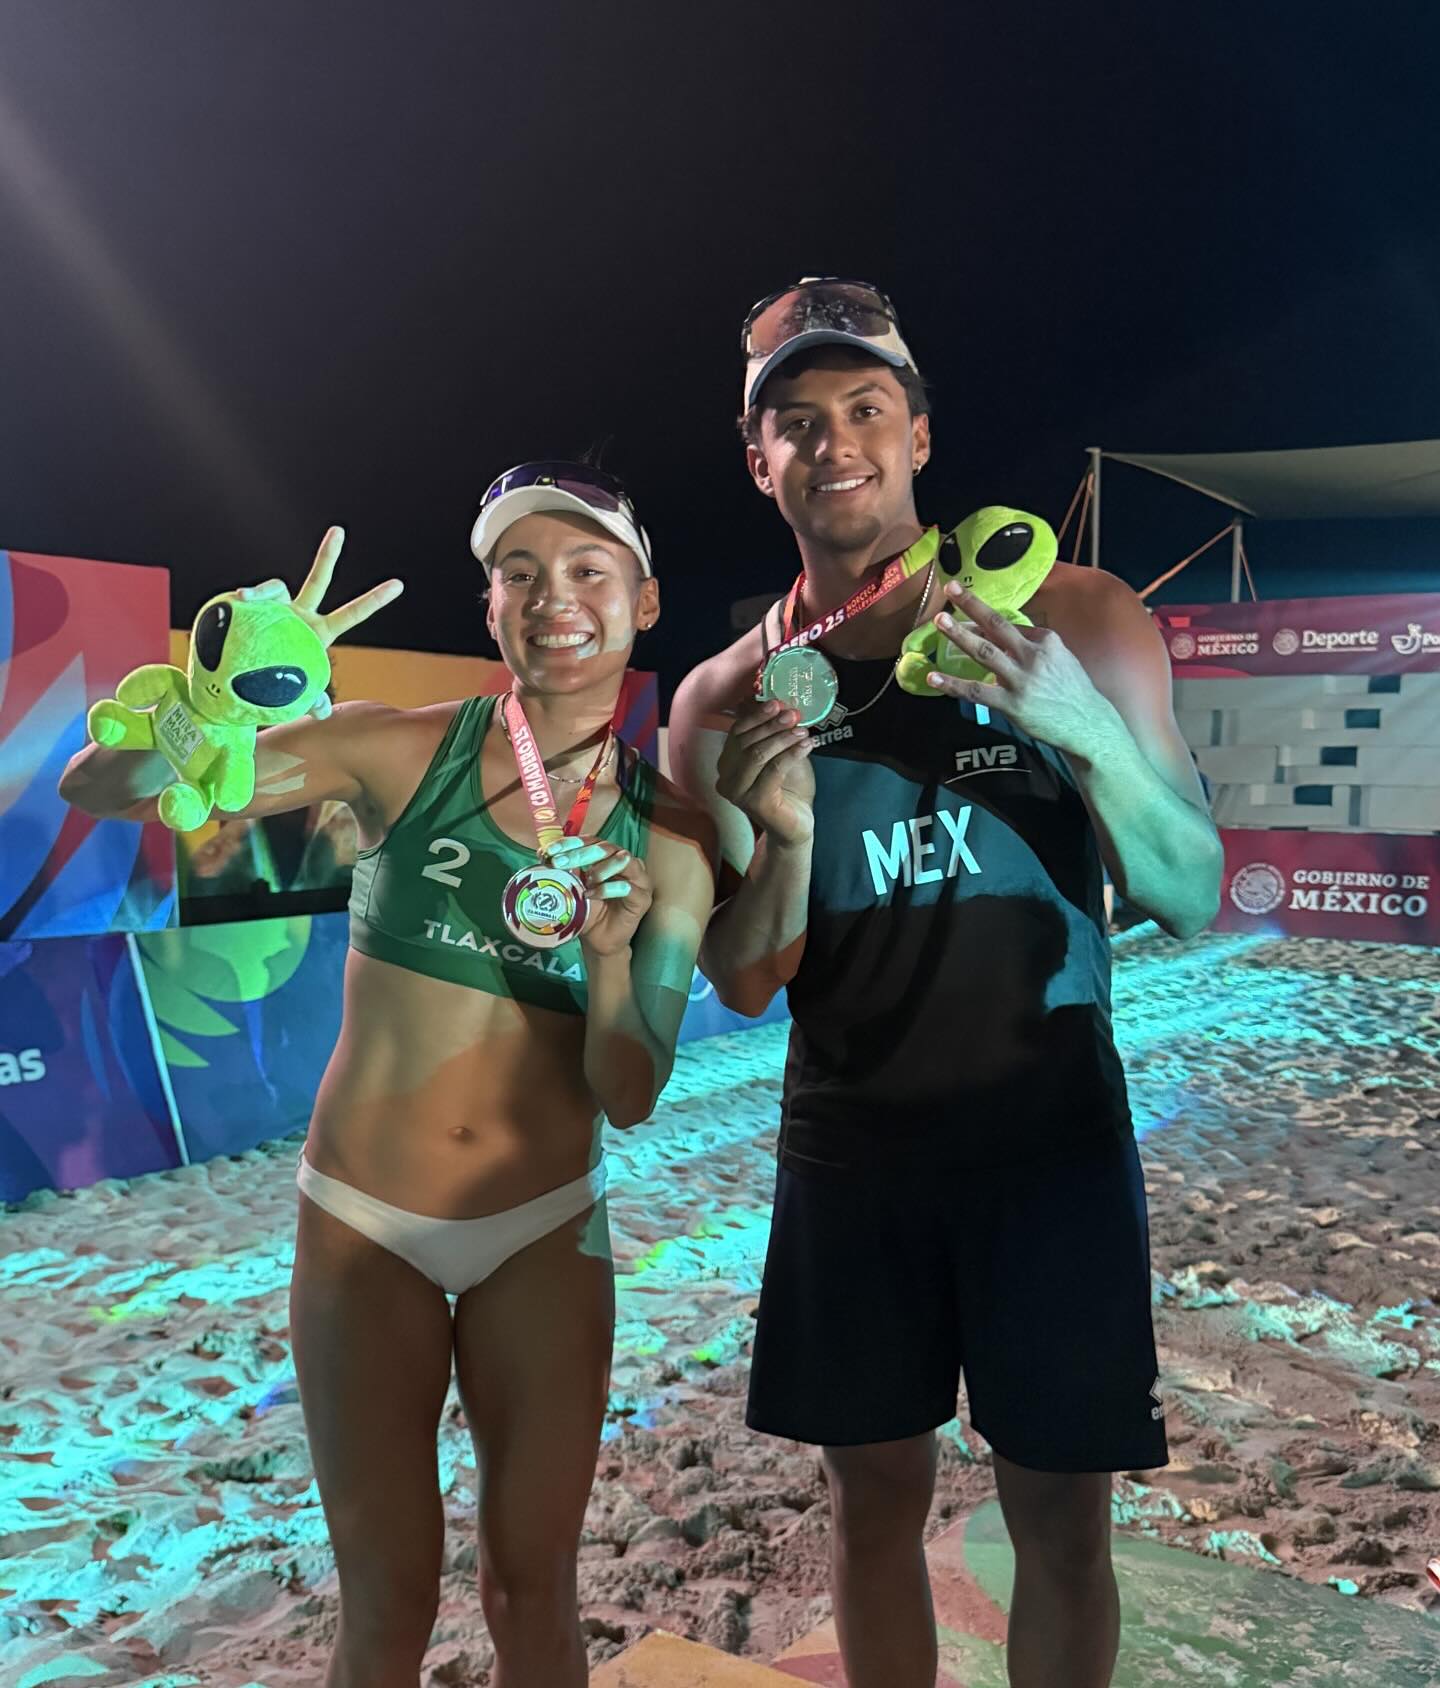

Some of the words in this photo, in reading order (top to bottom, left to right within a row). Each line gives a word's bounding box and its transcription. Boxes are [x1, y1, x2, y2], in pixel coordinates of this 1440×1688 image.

[824, 608, 845, 633] 25
[1197, 641, 1260, 656] MÉXICO
[1302, 629, 1379, 650] Deporte
[514, 726, 529, 746] 25
[518, 740, 546, 792] MADERO
[955, 744, 1018, 771] FIVB
[421, 837, 471, 889] 2
[861, 805, 983, 896] MEX
[1292, 869, 1397, 888] GOBIERNO
[1402, 875, 1430, 890] DE
[1288, 884, 1428, 917] MÉXICO
[423, 918, 584, 983] TLAXCALA
